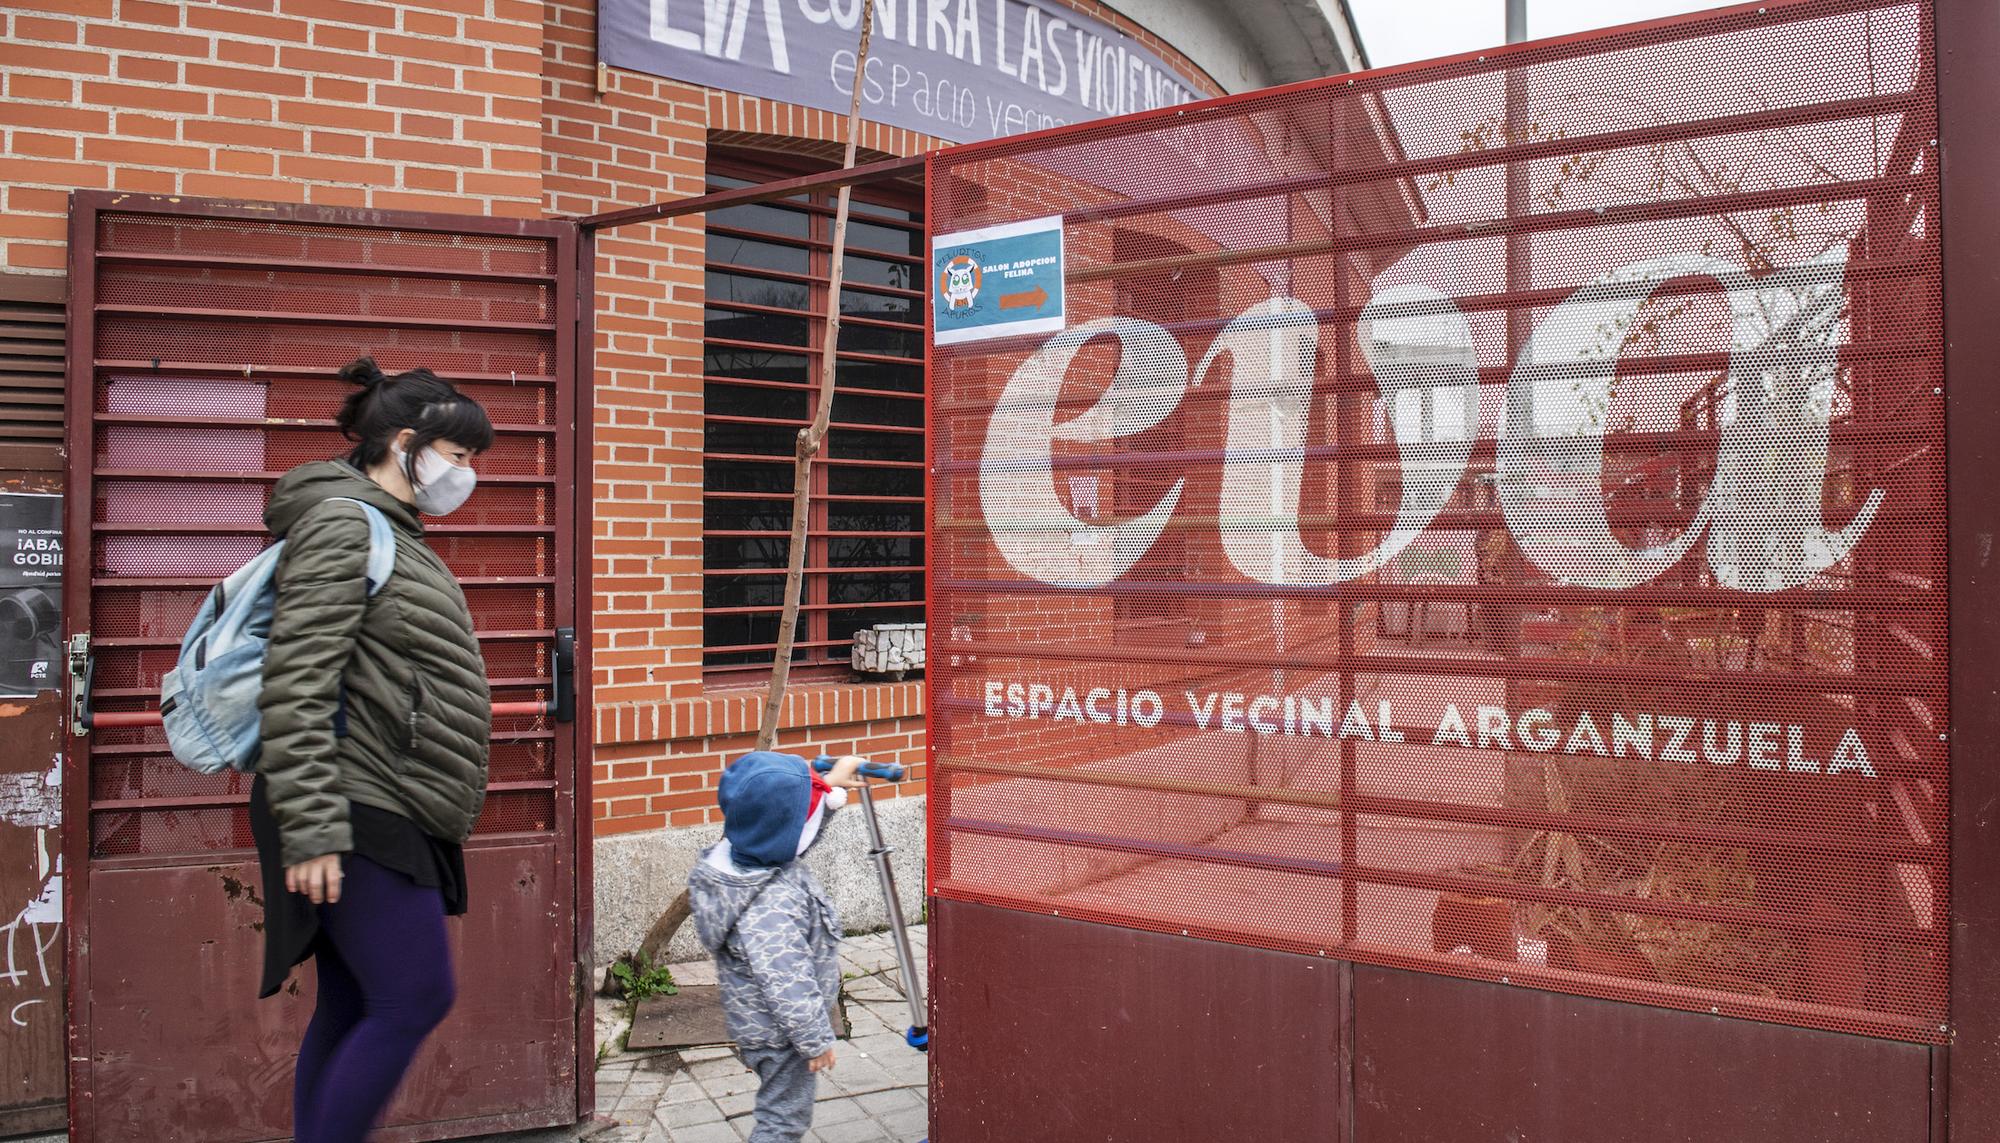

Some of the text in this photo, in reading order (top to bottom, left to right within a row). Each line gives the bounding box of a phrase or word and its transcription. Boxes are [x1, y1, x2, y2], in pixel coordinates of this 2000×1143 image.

[798, 0, 981, 66] NRA
[996, 0, 1068, 97] LAS
[1075, 29, 1192, 118] VIOLEN
[982, 256, 1057, 274] SALON ADOPCION
[1004, 268, 1034, 279] FELINA
[17, 538, 63, 551] ¡ABA
[984, 681, 1878, 778] ESPACIO VECINAL ARGANZUELA
